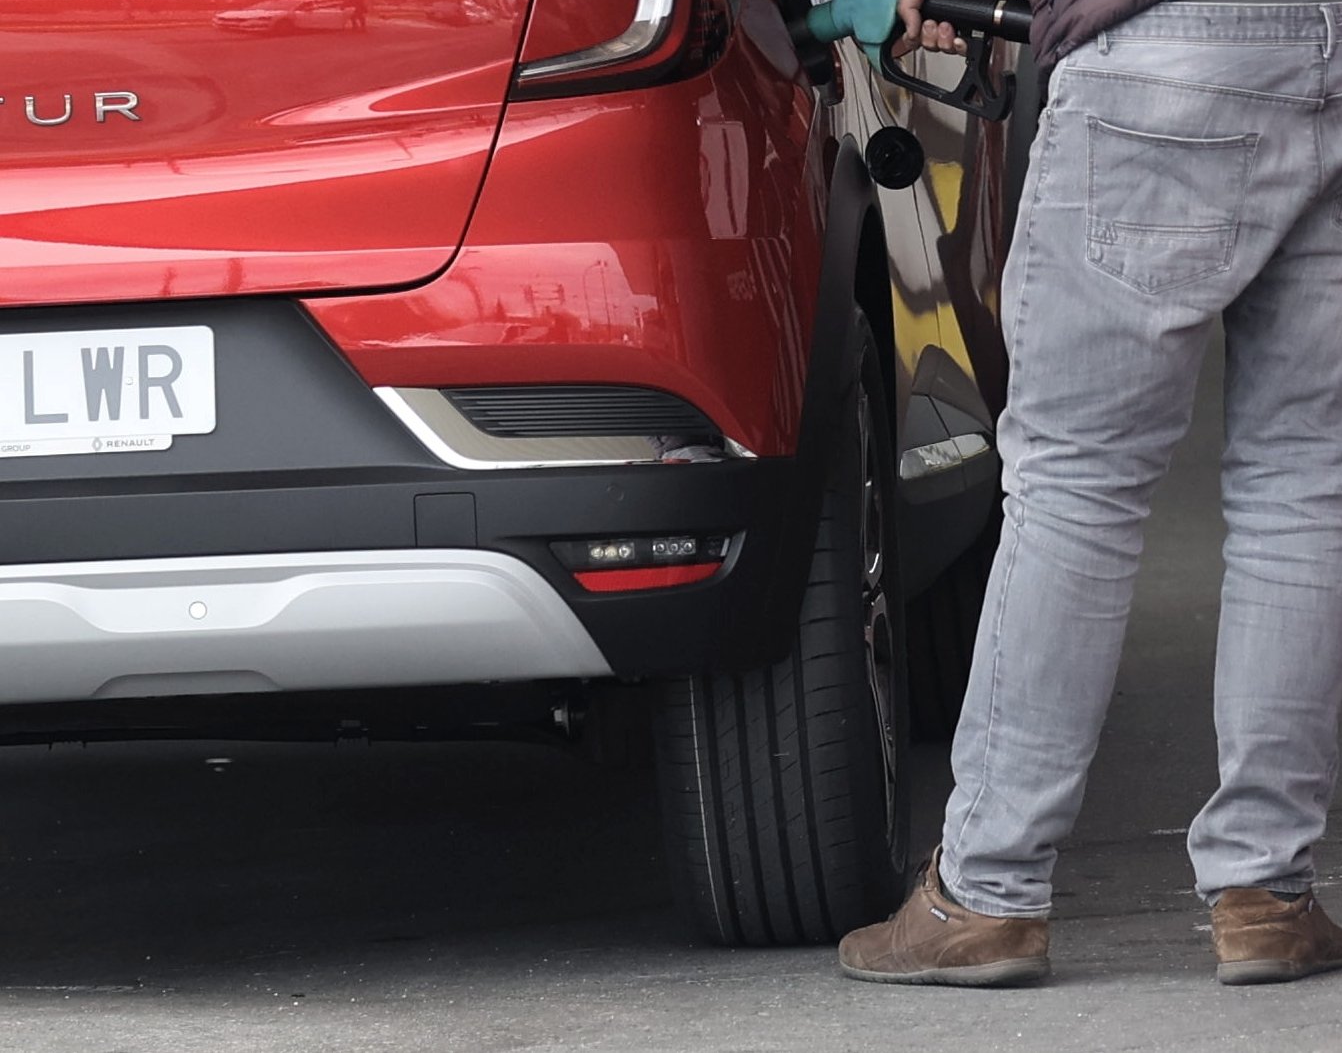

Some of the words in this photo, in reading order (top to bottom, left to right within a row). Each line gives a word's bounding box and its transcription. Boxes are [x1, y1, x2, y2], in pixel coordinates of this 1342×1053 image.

[0, 91, 141, 126] UR
[23, 345, 183, 425] LWR
[106, 438, 155, 448] RENAULT
